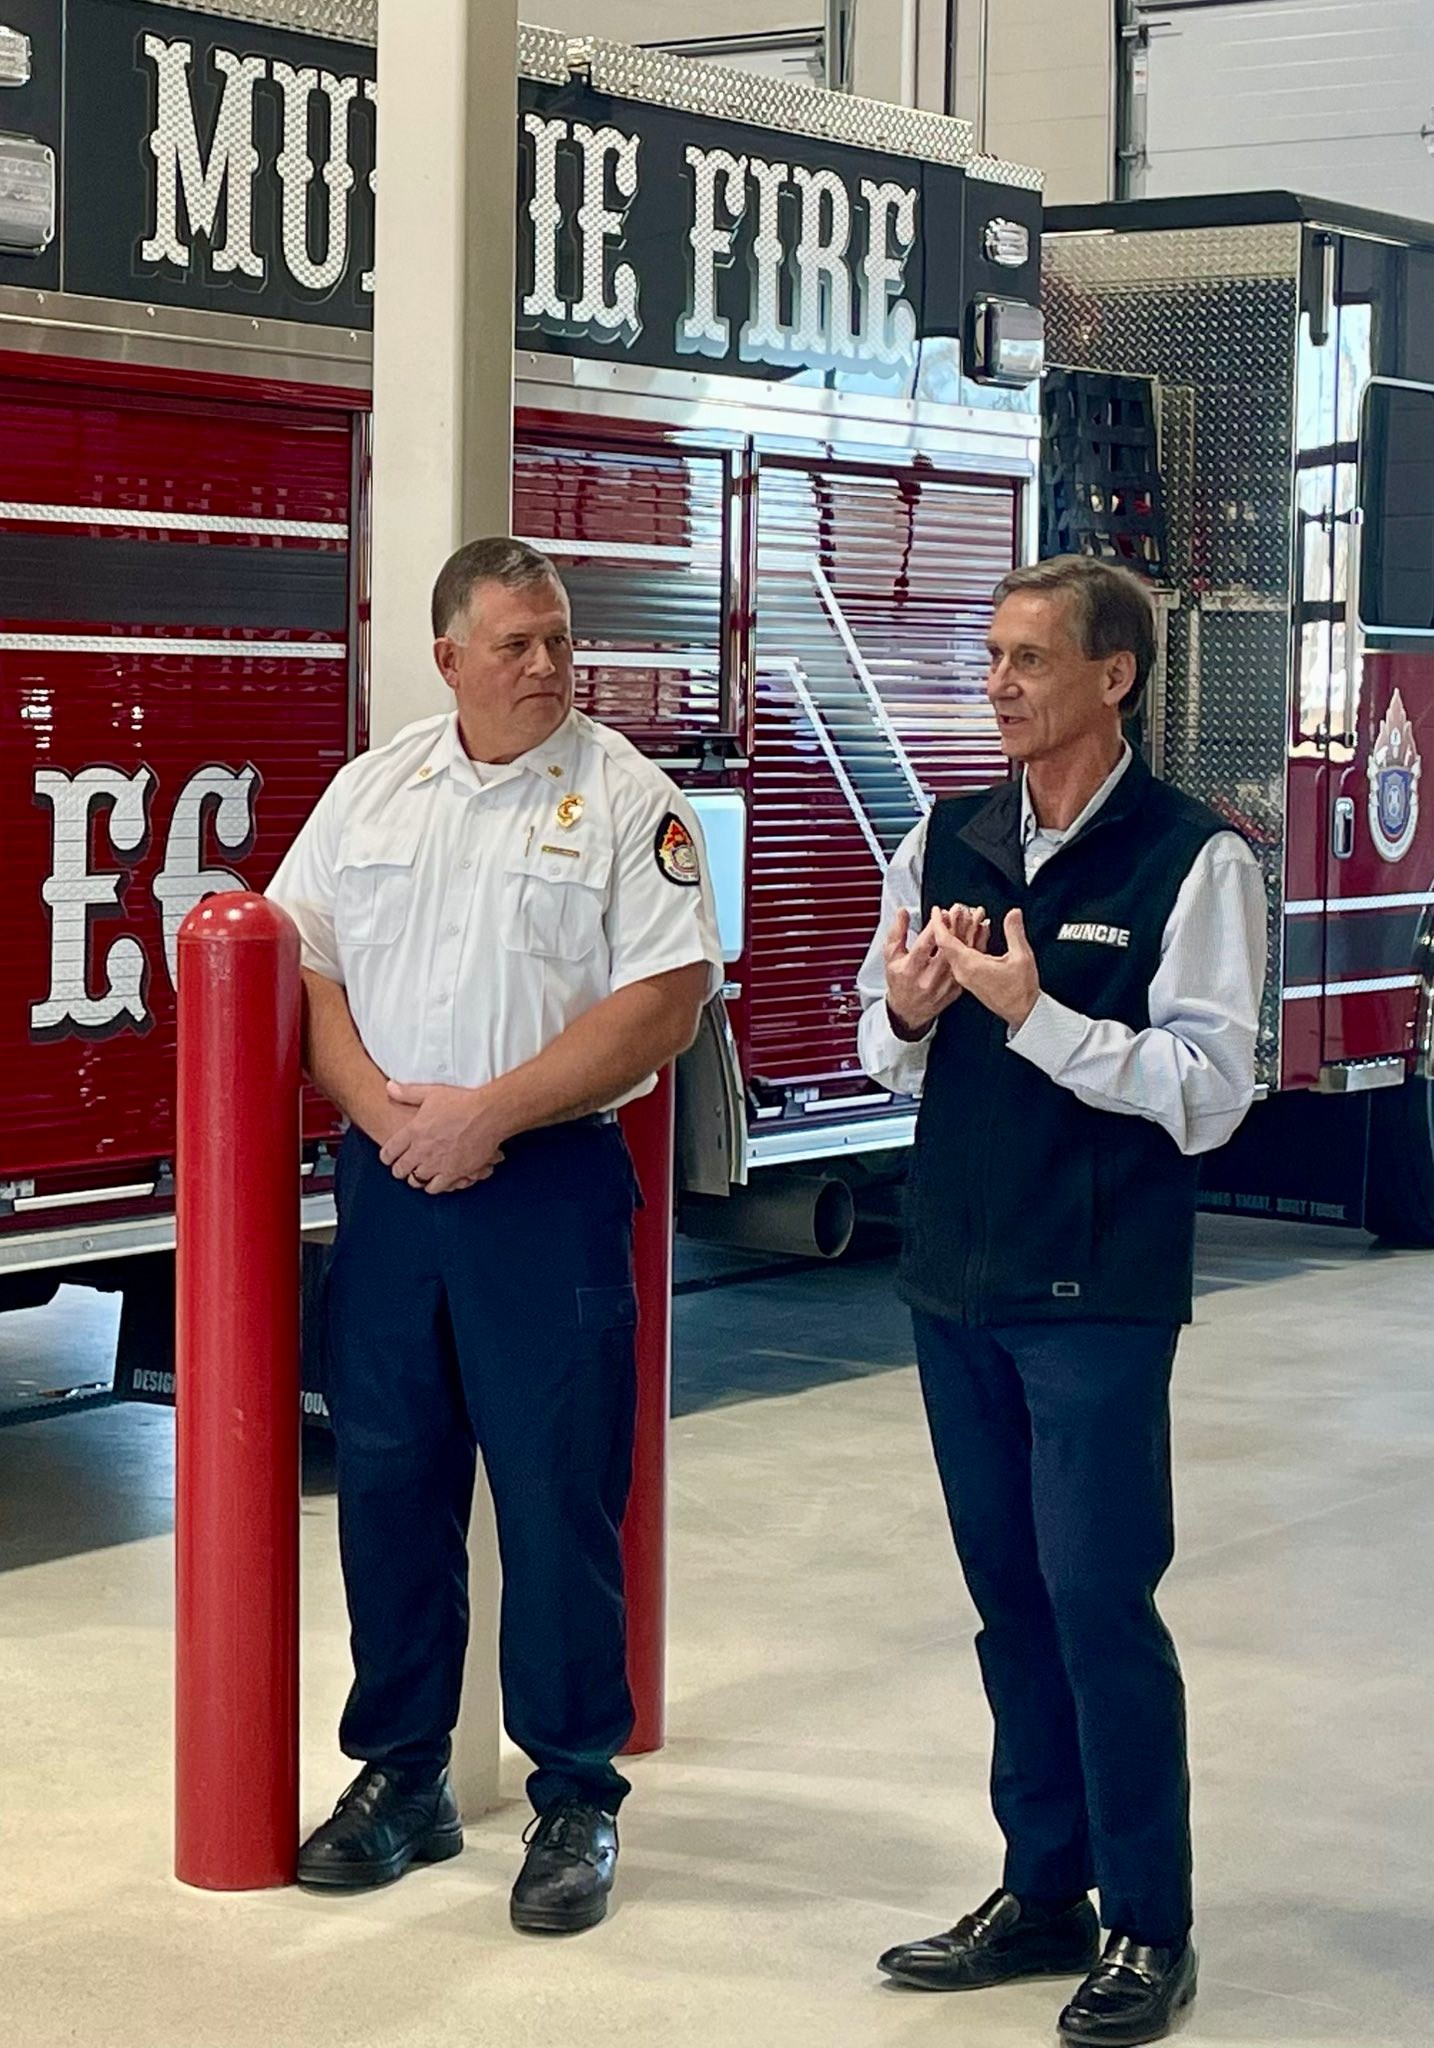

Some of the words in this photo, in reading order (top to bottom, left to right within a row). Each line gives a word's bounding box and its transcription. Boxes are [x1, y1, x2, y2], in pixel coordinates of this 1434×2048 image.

[139, 32, 643, 337] MUIE
[683, 145, 918, 368] FIRE
[31, 764, 256, 1030] E6
[1057, 923, 1130, 947] MUNCIE
